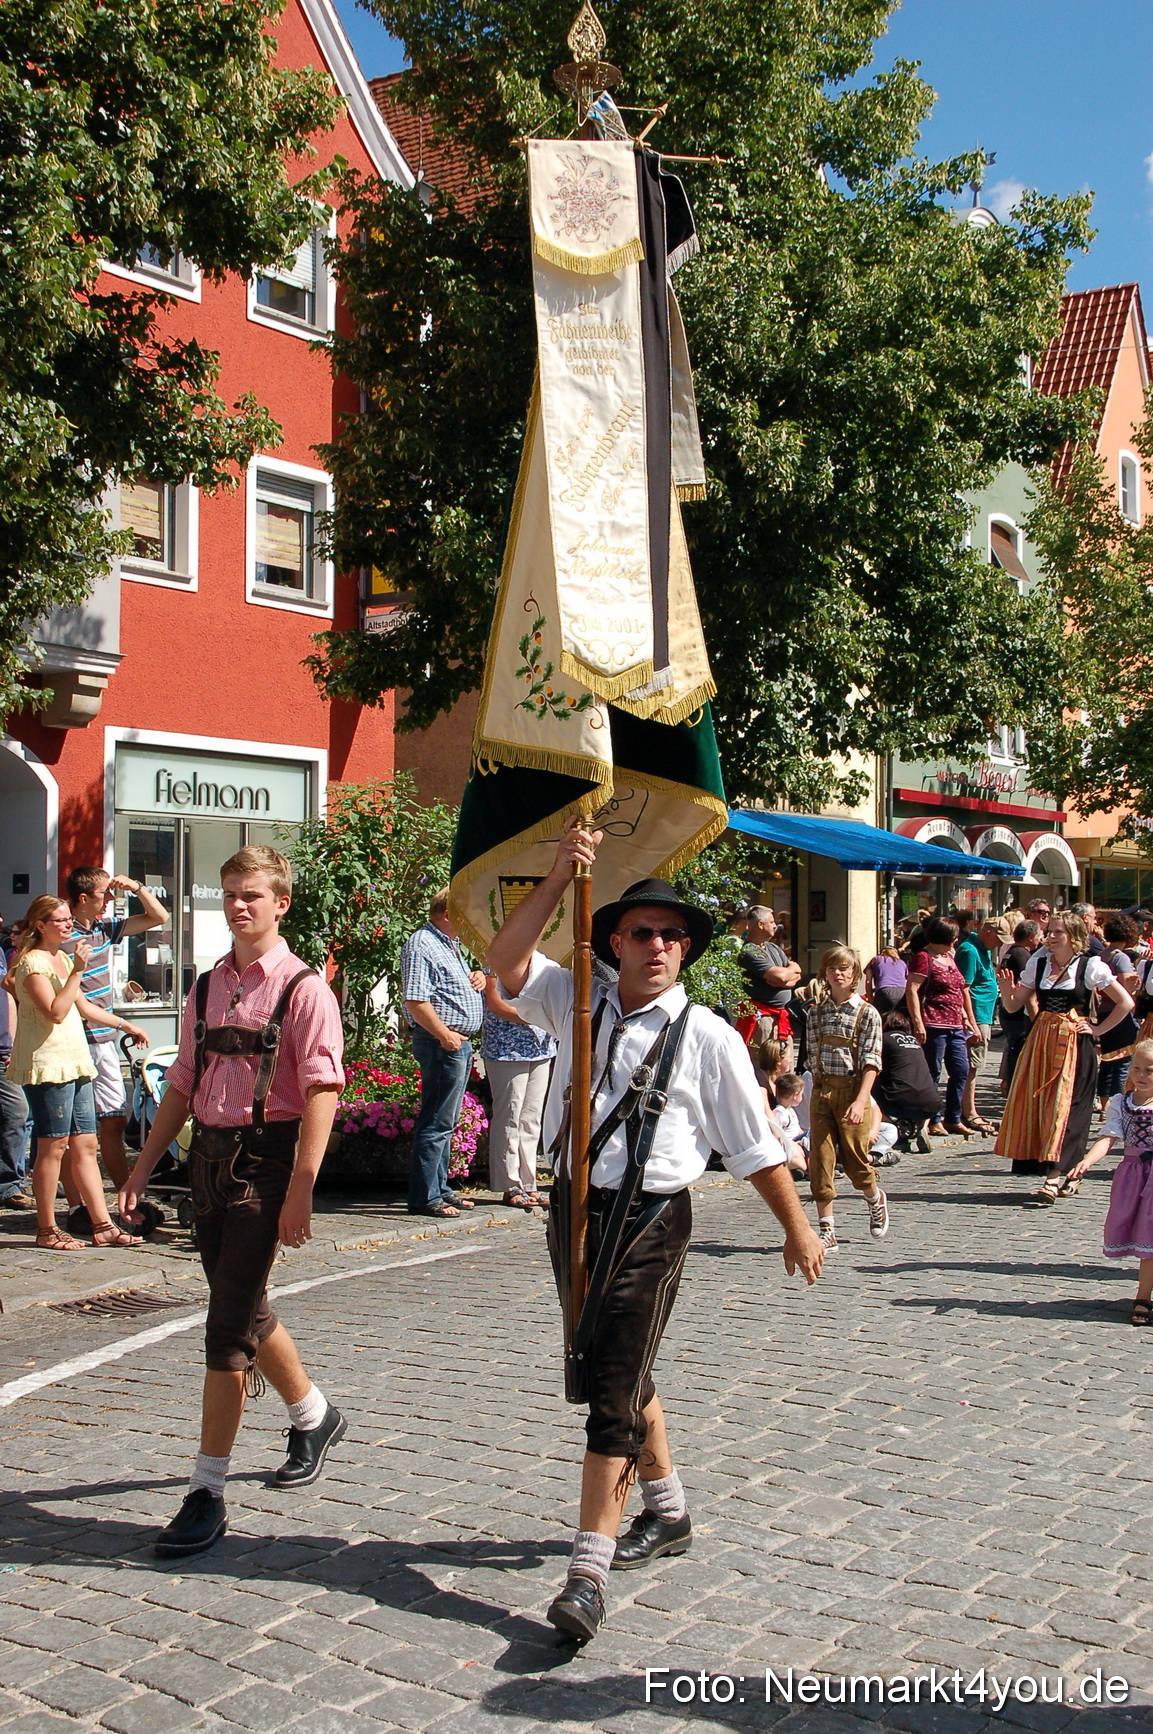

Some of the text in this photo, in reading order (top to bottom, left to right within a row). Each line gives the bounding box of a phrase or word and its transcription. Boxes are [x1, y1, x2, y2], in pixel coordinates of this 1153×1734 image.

[565, 346, 620, 362] gewidmet
[572, 365, 593, 376] von
[155, 767, 270, 811] fielmann
